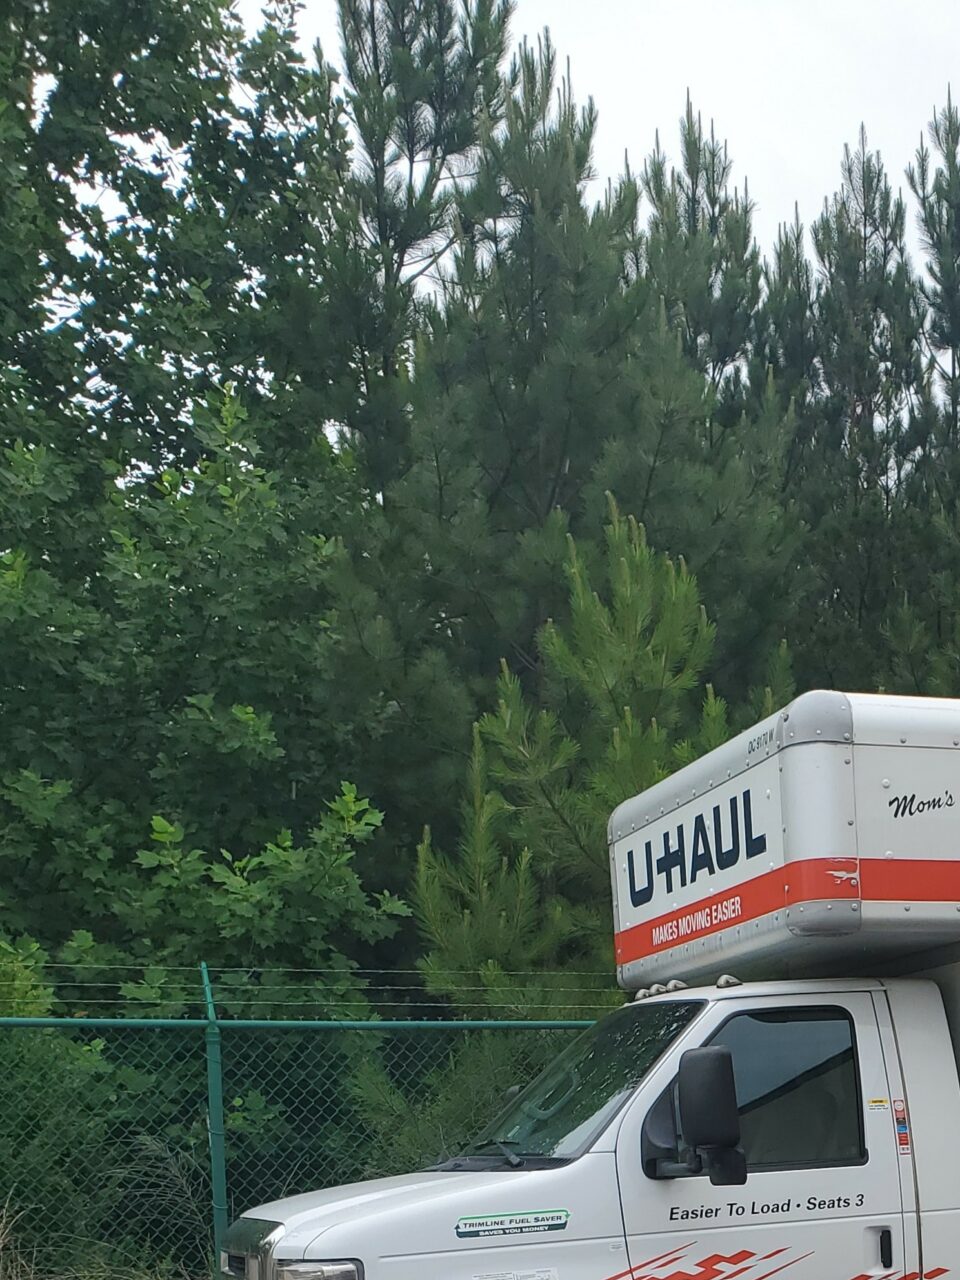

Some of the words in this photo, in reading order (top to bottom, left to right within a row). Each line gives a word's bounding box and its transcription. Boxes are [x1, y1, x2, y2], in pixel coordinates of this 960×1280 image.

[888, 790, 955, 818] Mom's
[652, 921, 677, 946] MAKES
[678, 909, 711, 936] MOVING
[712, 896, 741, 924] EASIER
[534, 1215, 562, 1223] SAVER
[669, 1205, 722, 1221] Easier
[727, 1203, 745, 1217] To
[750, 1198, 791, 1215] Load
[806, 1195, 851, 1211] Seats
[855, 1193, 865, 1208] 3
